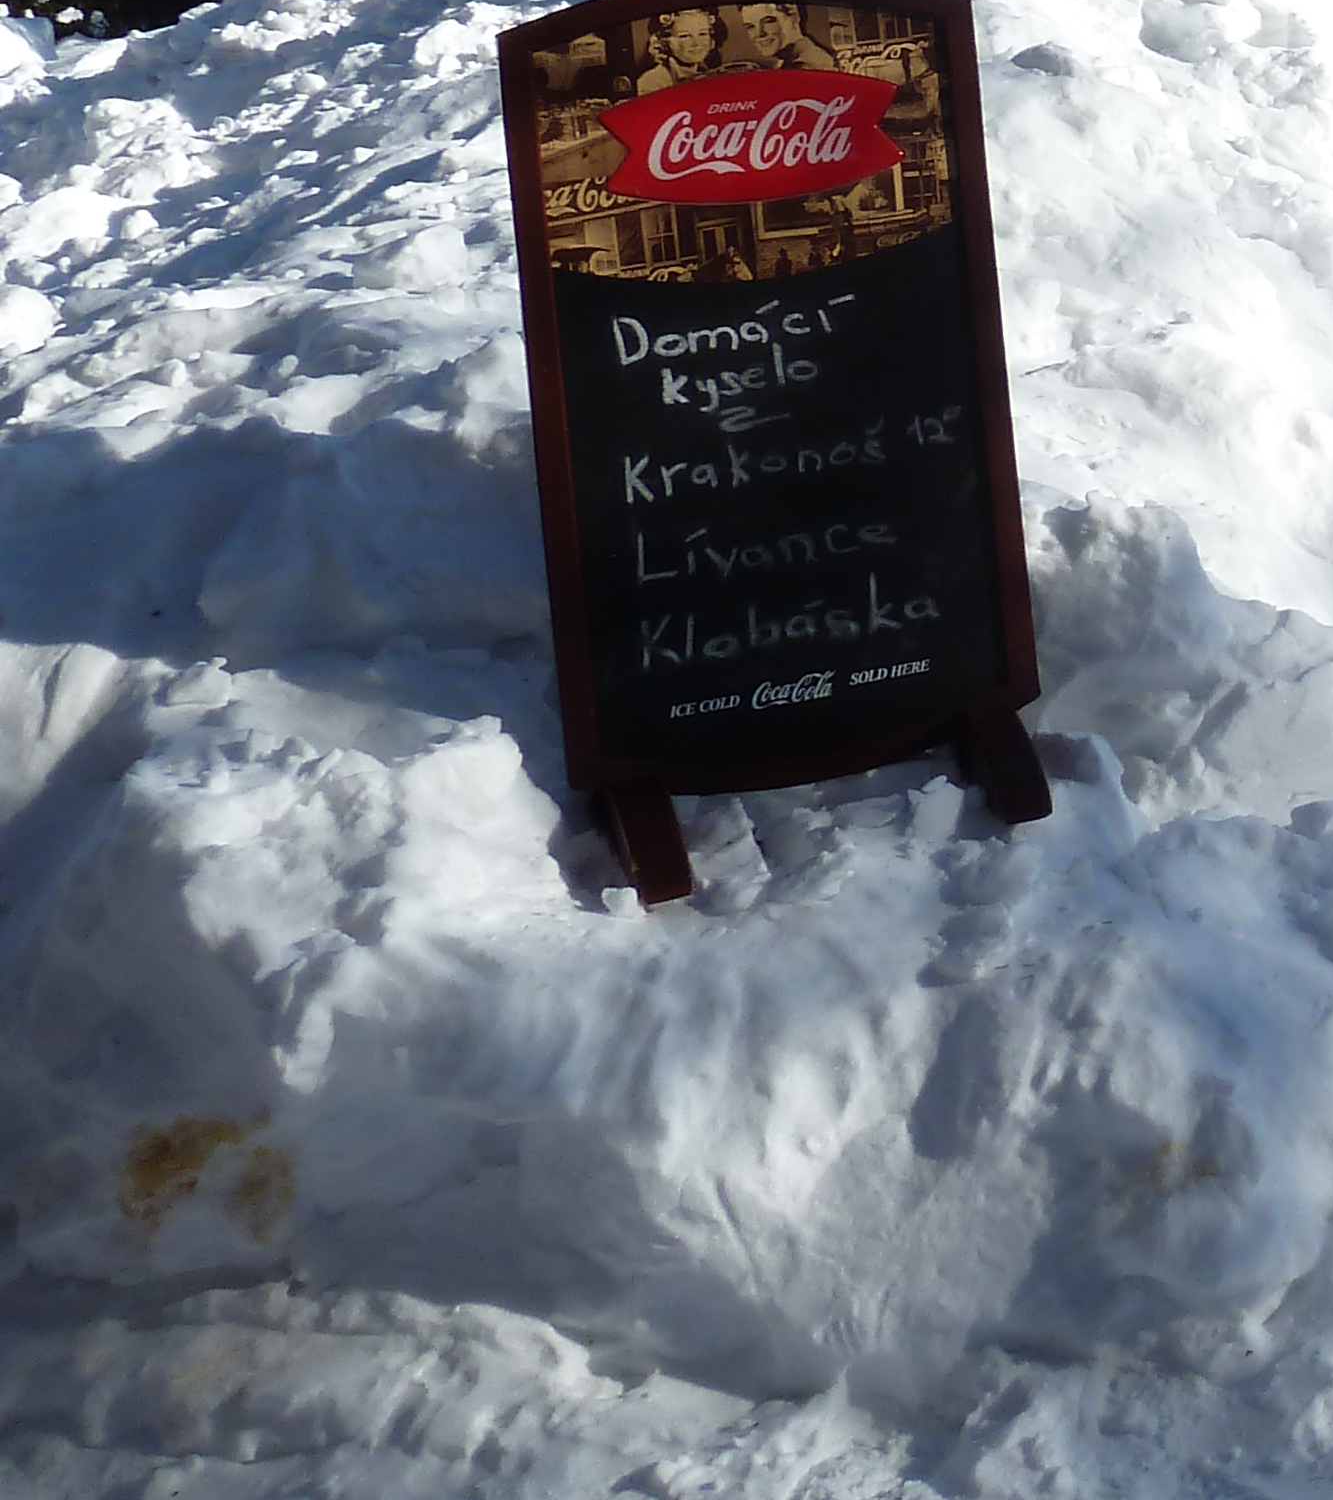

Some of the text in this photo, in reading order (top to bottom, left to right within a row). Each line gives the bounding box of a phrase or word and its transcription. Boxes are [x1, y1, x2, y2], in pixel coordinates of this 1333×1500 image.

[647, 95, 857, 182] Coca-Cola
[706, 100, 759, 115] DRINK
[622, 415, 886, 505] Krakonoš
[669, 658, 931, 719] ICE COLD Coca-Cola SOLD HERE
